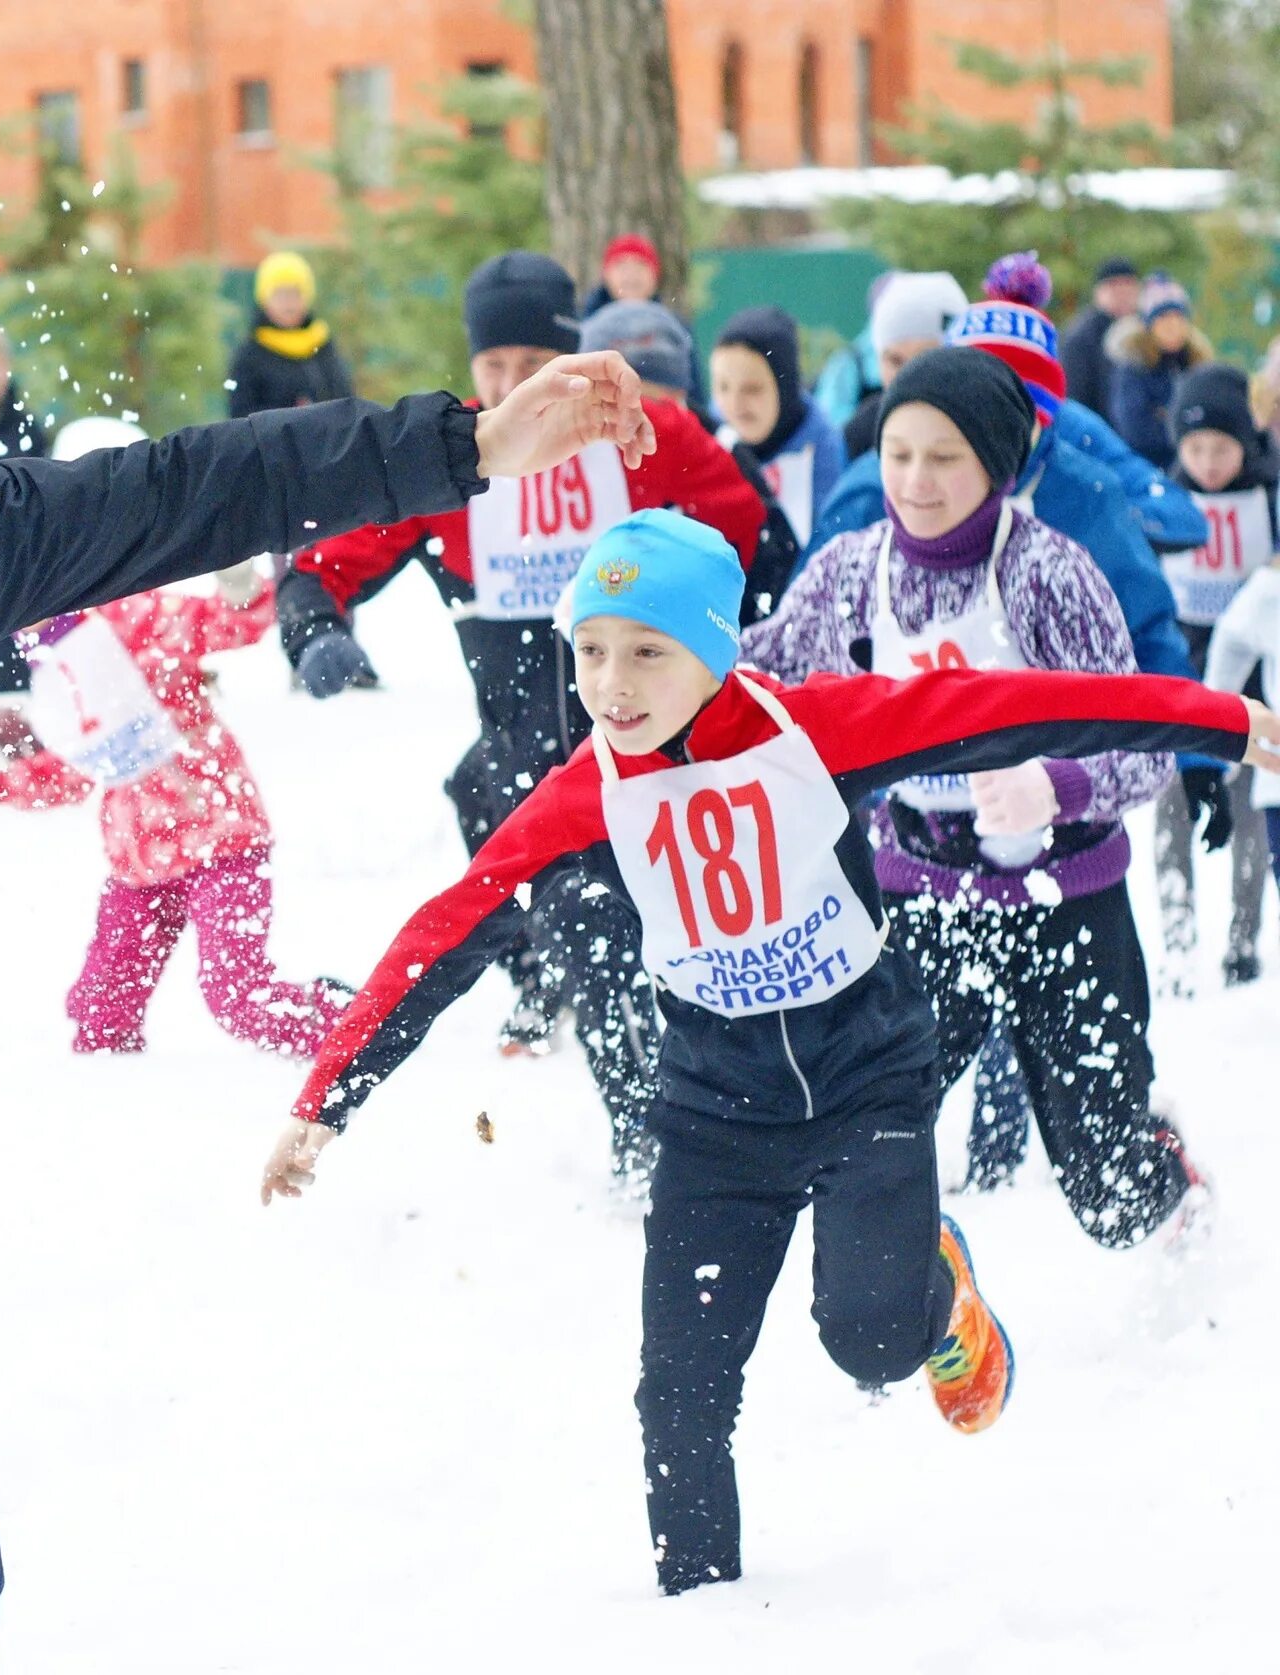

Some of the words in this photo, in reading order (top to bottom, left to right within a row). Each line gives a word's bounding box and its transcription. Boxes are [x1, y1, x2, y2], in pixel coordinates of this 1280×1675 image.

[519, 454, 593, 537] 109
[488, 547, 588, 570] КОНАКО
[1193, 507, 1243, 572] 01
[499, 590, 560, 609] СПО
[707, 608, 739, 644] NORD
[645, 779, 783, 948] 187
[695, 948, 852, 1009] СПОРТ!
[711, 938, 818, 987] ЛЮБИТ
